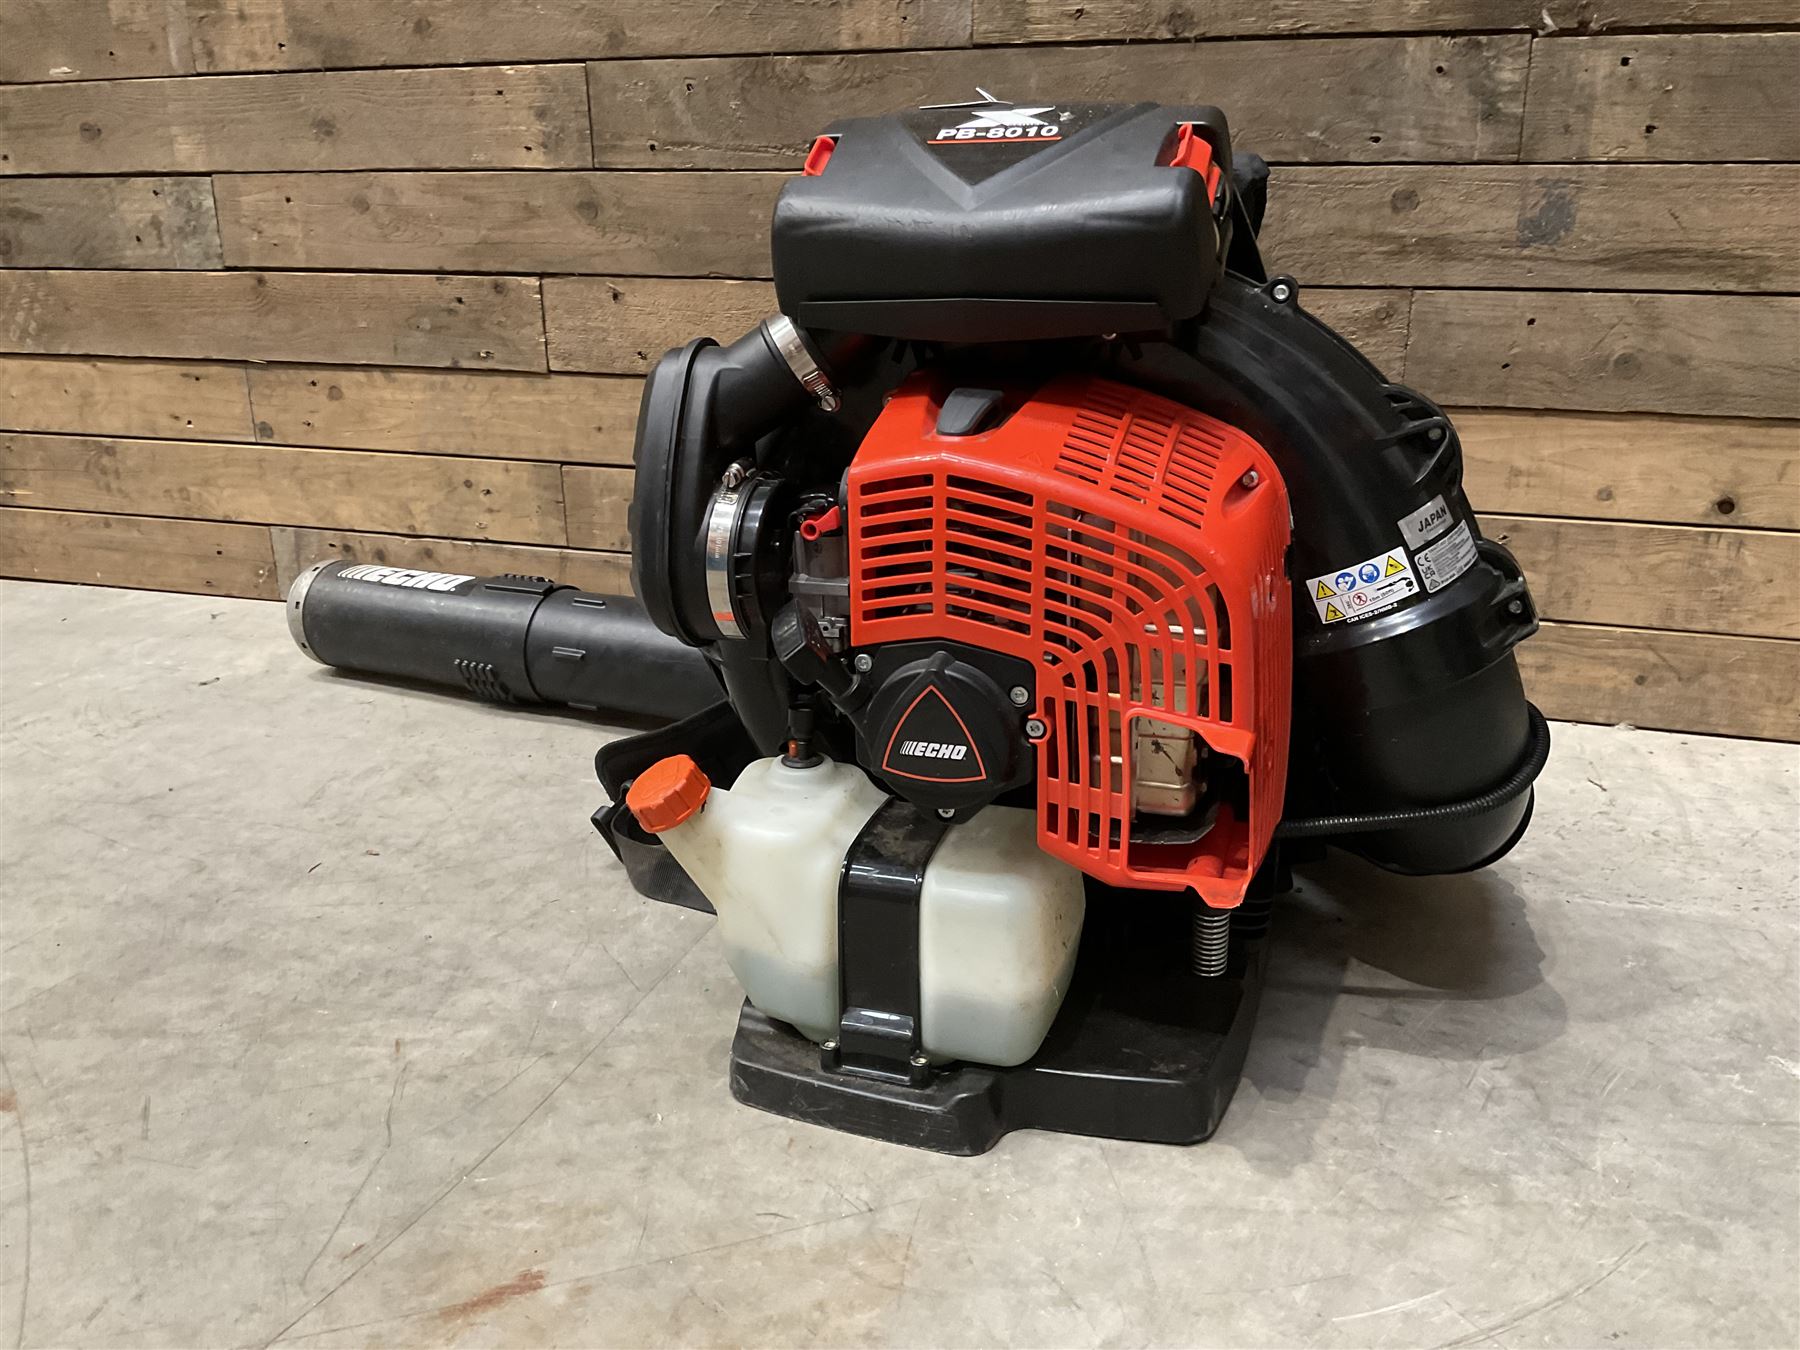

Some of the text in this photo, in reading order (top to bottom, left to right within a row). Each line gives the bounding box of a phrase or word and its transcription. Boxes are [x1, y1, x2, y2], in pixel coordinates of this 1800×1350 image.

[936, 125, 1060, 140] PB-8010
[1418, 505, 1447, 532] JAPAN
[360, 566, 476, 592] ECHO
[914, 741, 968, 760] ECHO
